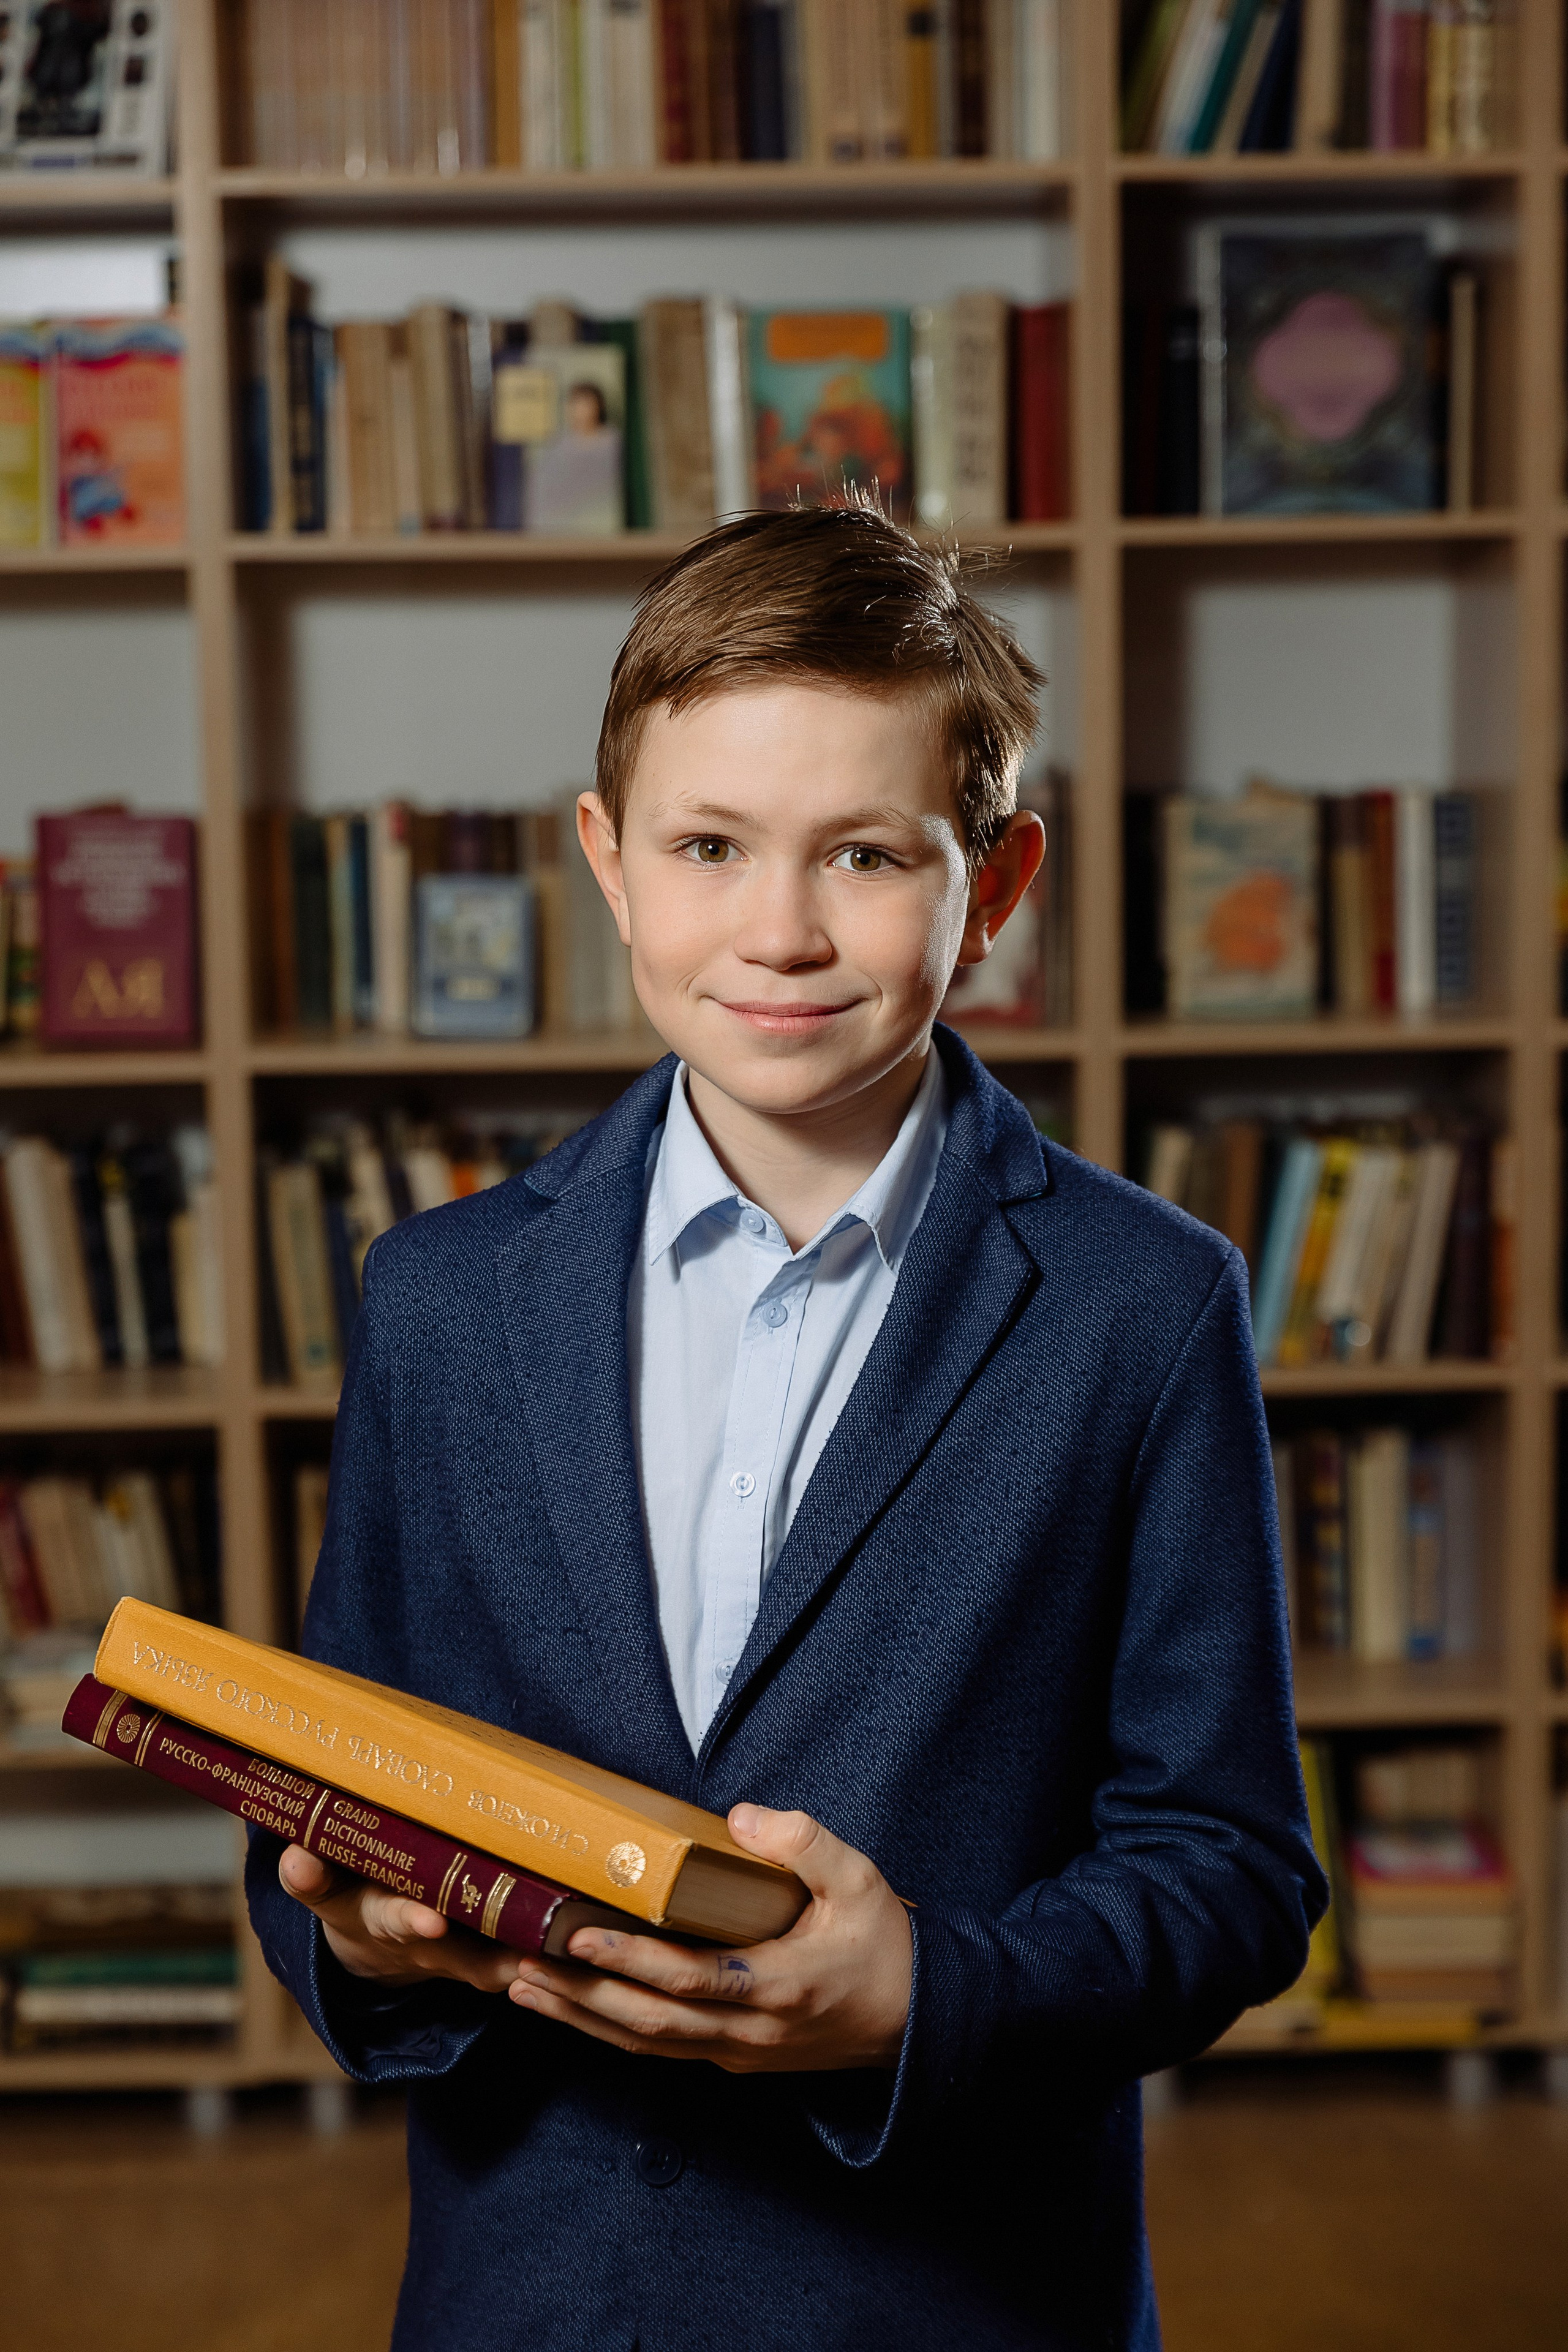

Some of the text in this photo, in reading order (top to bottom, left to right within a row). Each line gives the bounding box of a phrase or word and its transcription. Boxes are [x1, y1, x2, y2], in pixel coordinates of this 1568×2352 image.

[132, 1641, 214, 1692] ЯЗЫКА
[216, 1679, 340, 1750] РУССКОГО
[159, 1736, 306, 1819] РУССКО-ФРАНЦУЗСКИЙ
[247, 1758, 316, 1800] БОЛЬШОЙ
[348, 1735, 454, 1796] СЛОВАРЬ
[239, 1800, 297, 1838] СЛОВАРЬ
[333, 1800, 380, 1830] GRAND
[323, 1817, 417, 1872] DICTIONNAIRE
